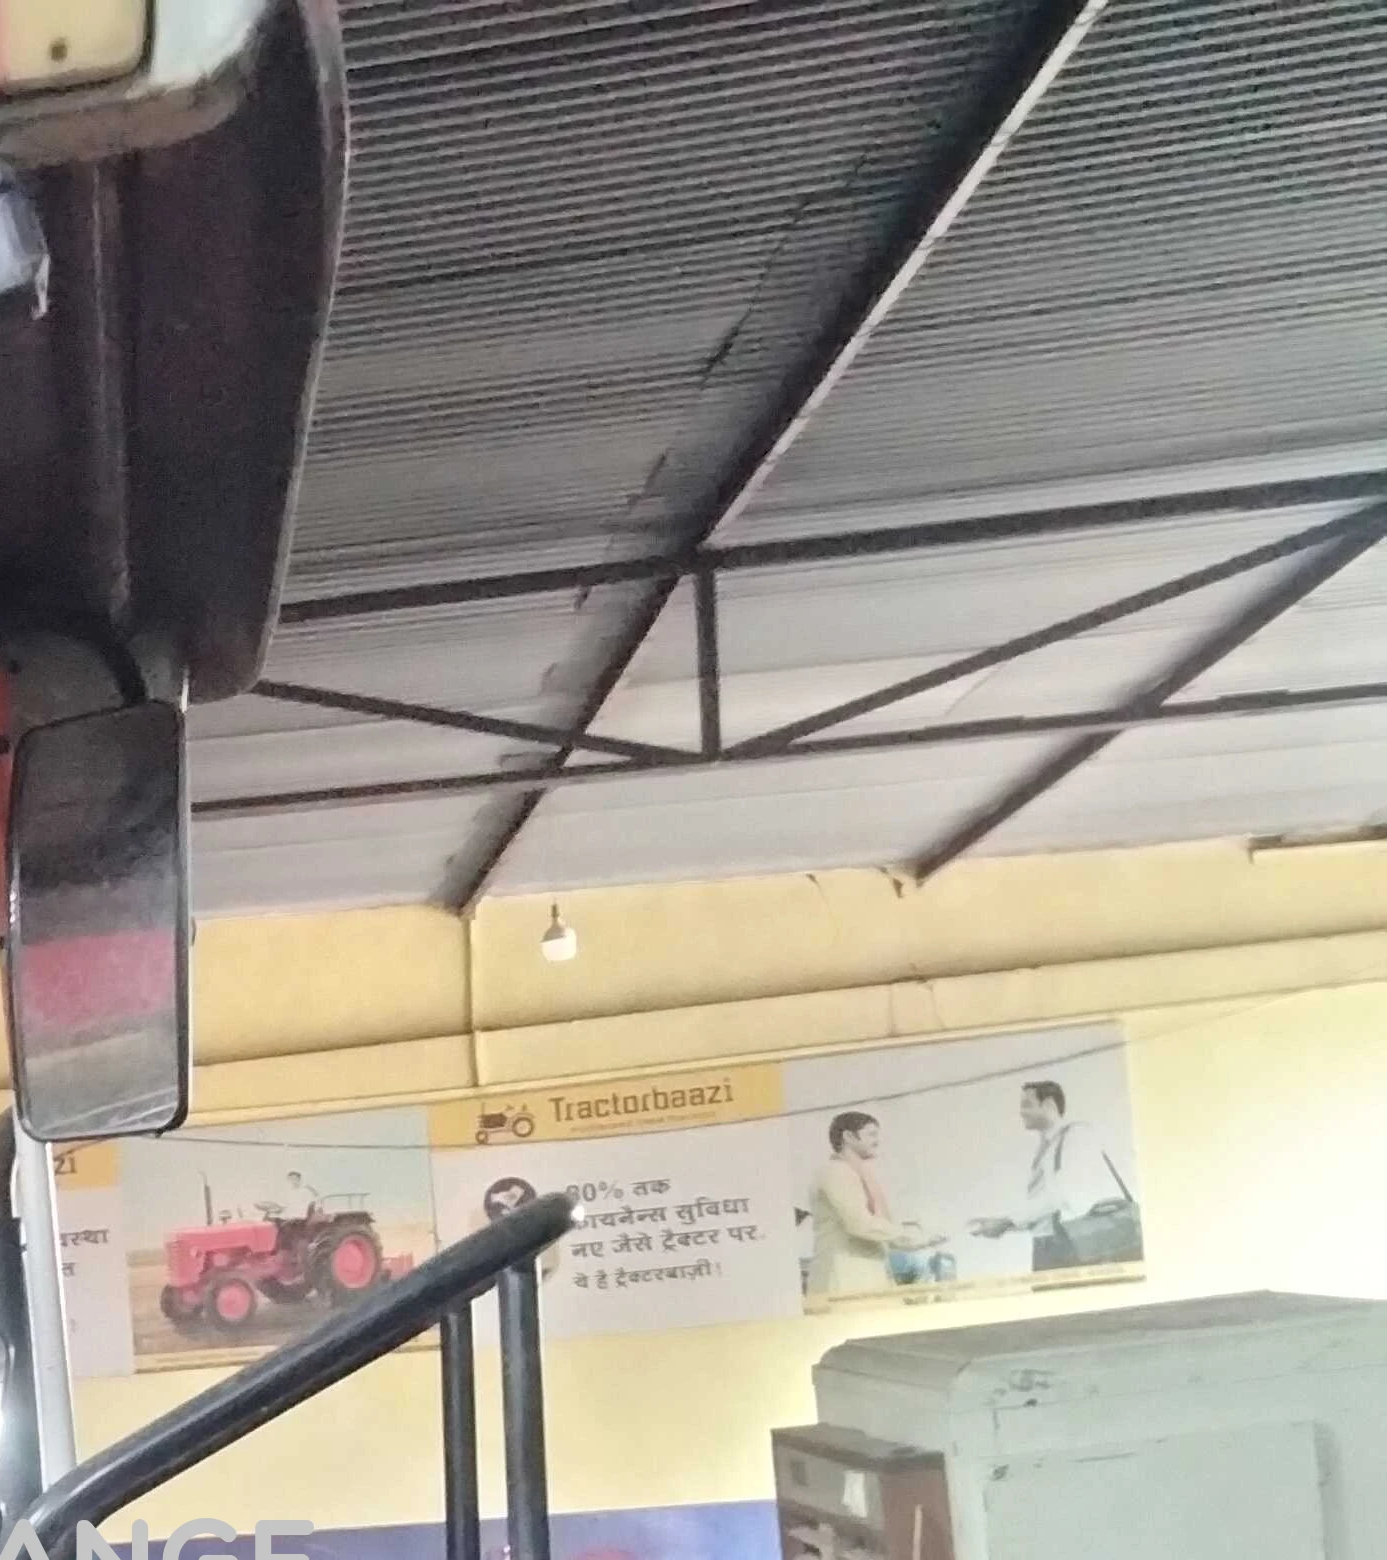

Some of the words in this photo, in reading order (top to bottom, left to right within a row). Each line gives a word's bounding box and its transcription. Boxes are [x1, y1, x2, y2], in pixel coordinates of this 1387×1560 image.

[548, 1077, 734, 1123] Tractorbaazi
[629, 1178, 671, 1197] तक
[674, 1195, 751, 1225] सुविधा
[571, 1240, 605, 1258] नए
[611, 1232, 653, 1254] जैसे
